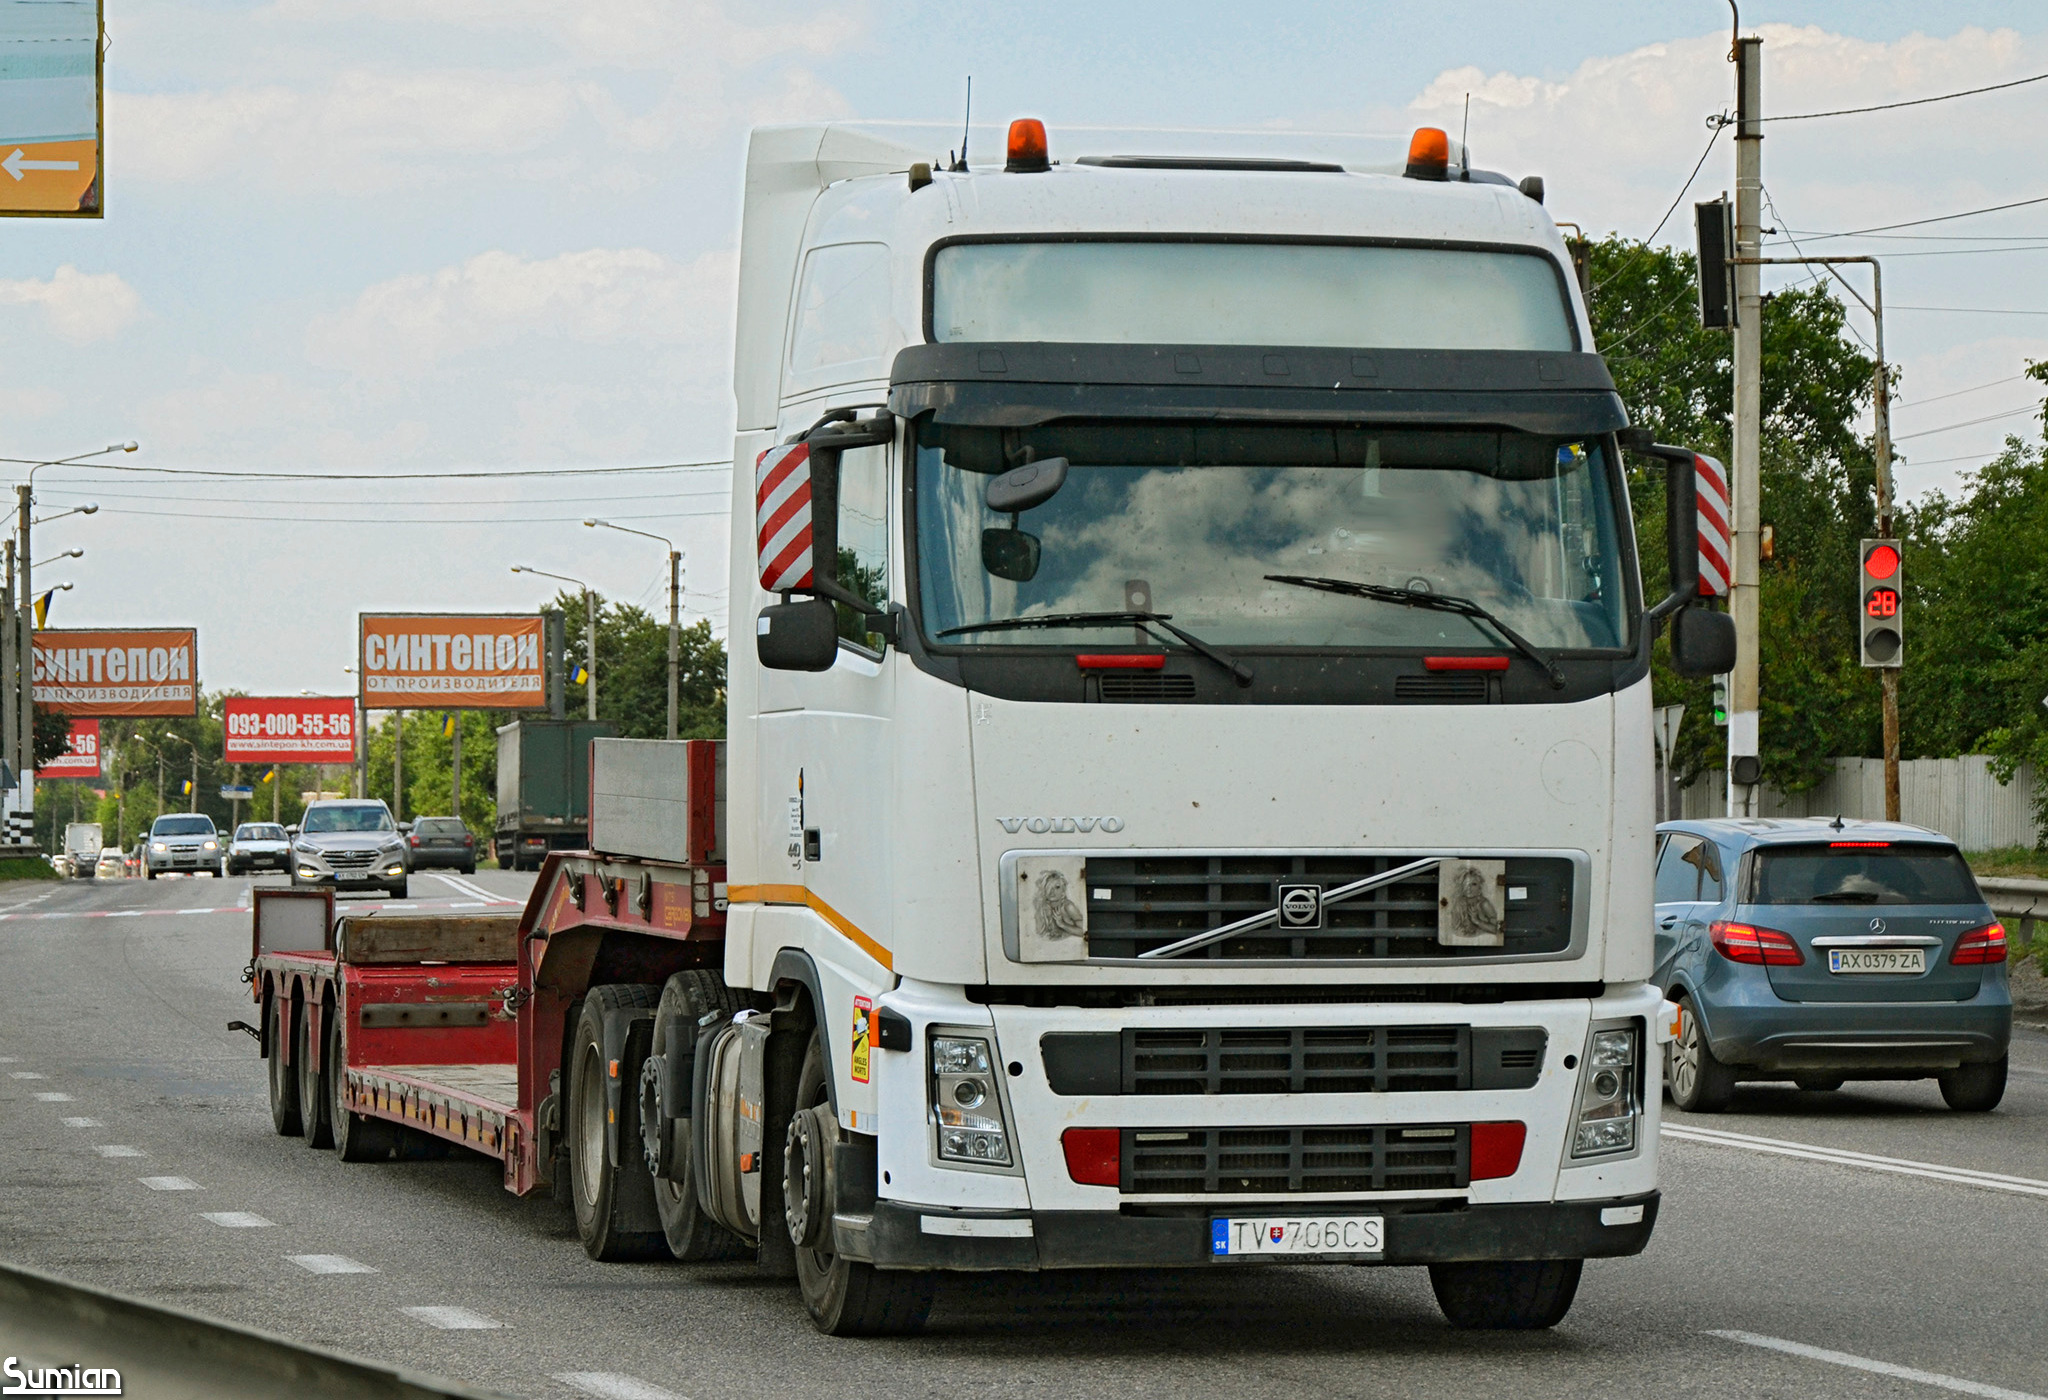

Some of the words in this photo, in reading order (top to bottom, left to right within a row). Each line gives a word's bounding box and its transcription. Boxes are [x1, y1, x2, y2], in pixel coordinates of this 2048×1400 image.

[1867, 590, 1896, 616] 28
[368, 678, 388, 689] ОТ
[396, 677, 541, 690] ПРОИЗВОДИТЕЛЯ
[55, 687, 191, 700] ПРОИЗВОДИТЕЛЯ
[228, 713, 351, 735] 093-000-55-56
[996, 816, 1124, 834] VOLVO
[1841, 954, 1861, 968] AX
[1863, 954, 1897, 968] 0379
[1900, 954, 1921, 968] ZA
[854, 1055, 867, 1067] ANGLES
[1233, 1222, 1267, 1250] TV
[1287, 1221, 1379, 1250] 706CS
[1215, 1241, 1226, 1250] SK
